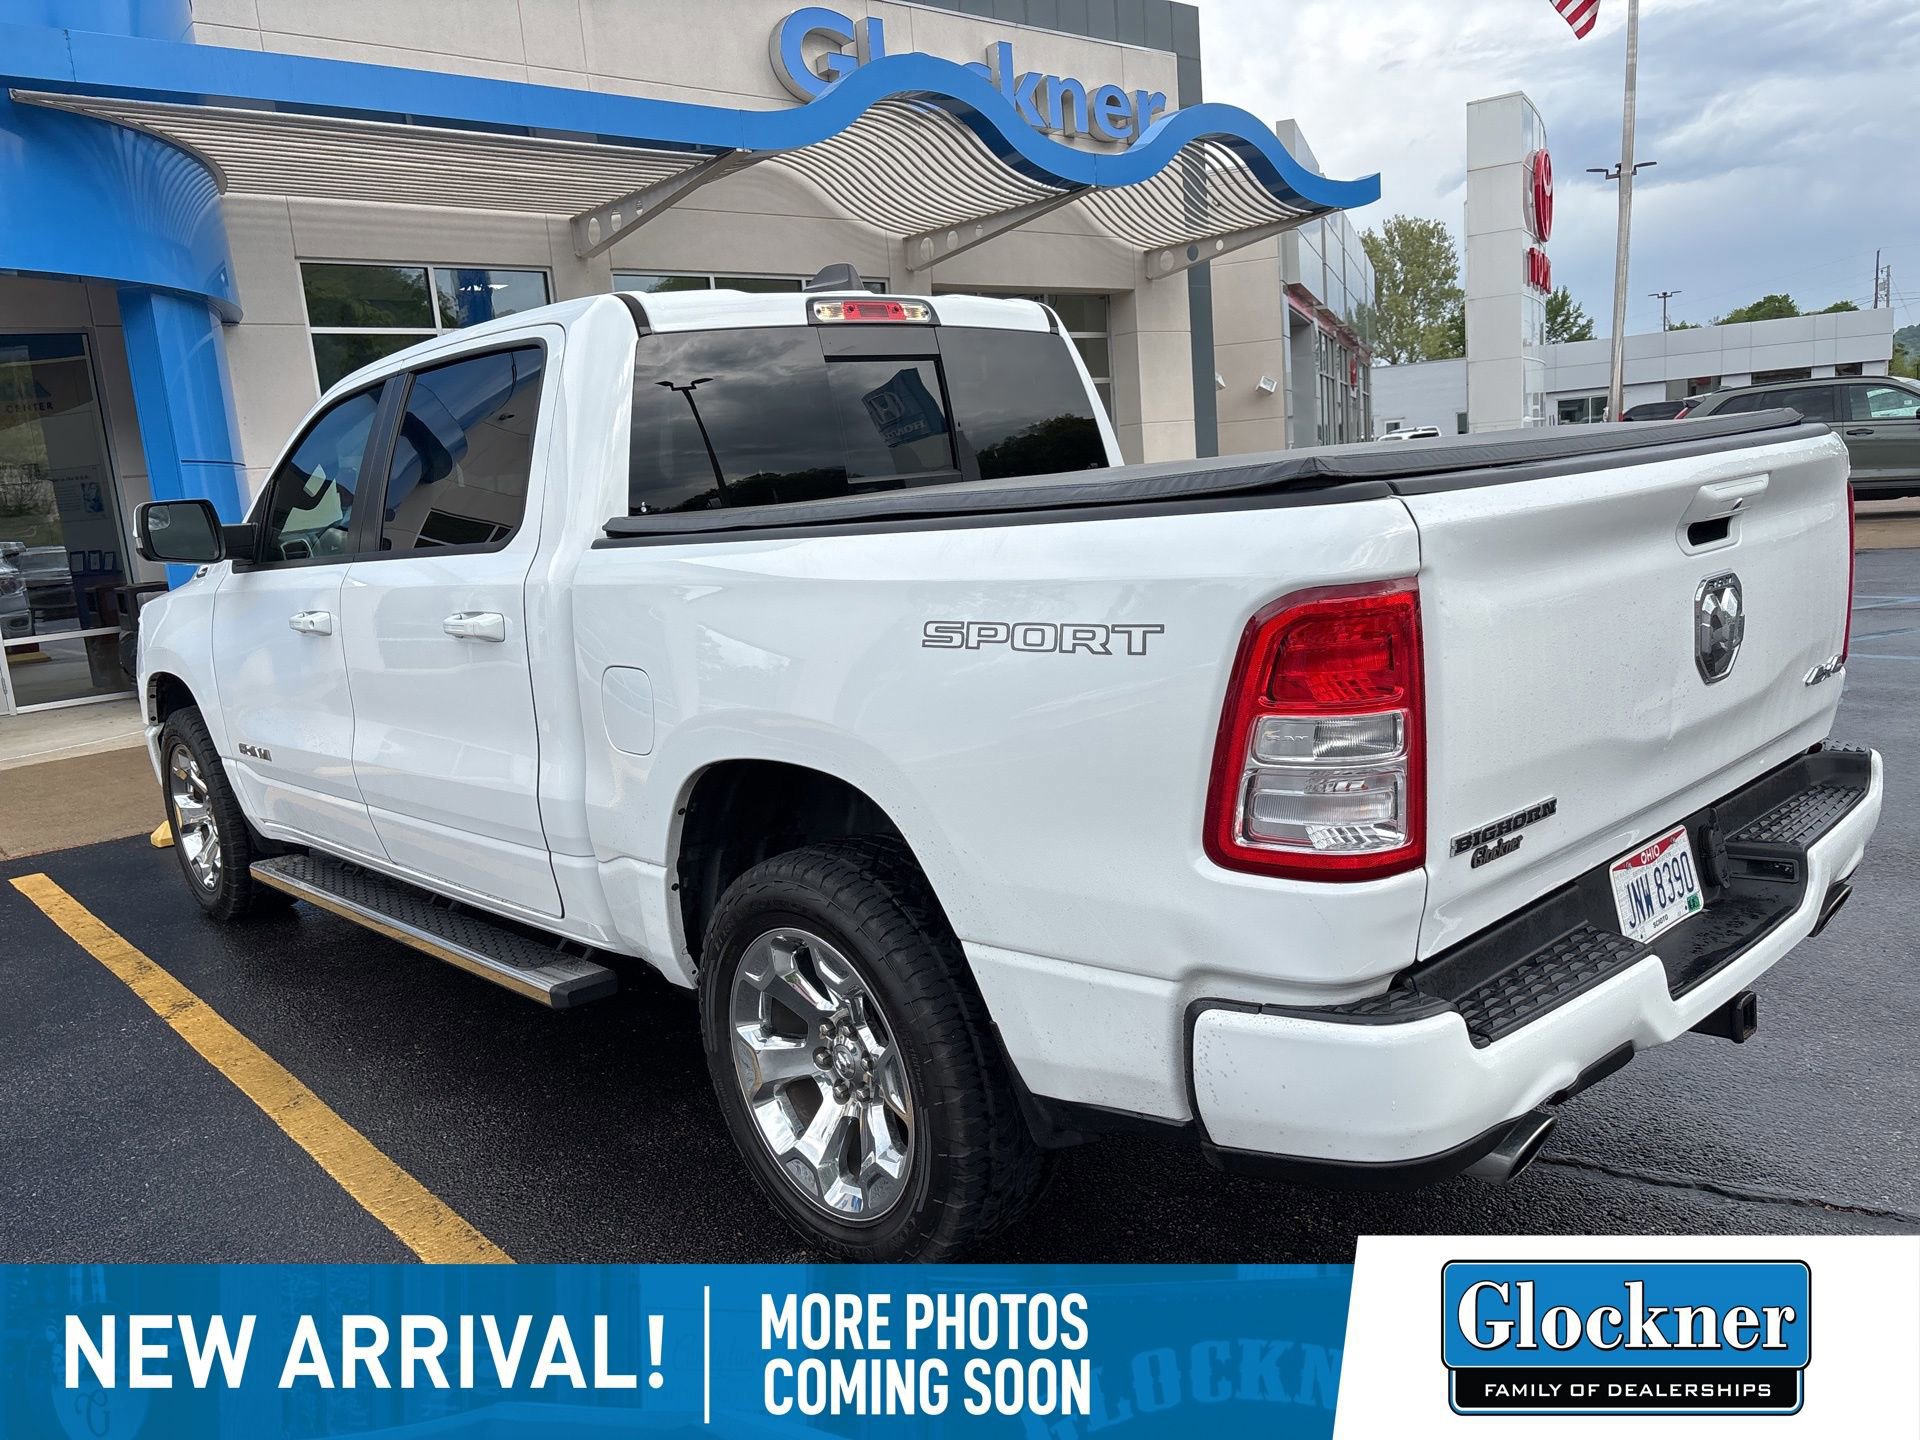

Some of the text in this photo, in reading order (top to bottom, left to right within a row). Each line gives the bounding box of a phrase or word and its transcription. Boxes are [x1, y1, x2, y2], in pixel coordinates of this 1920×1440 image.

[922, 620, 1165, 656] SPORT
[1471, 834, 1523, 869] Glockner
[1640, 844, 1661, 865] OHIO
[1627, 851, 1695, 928] JNW 8390
[1652, 914, 1669, 929] SCIOTO
